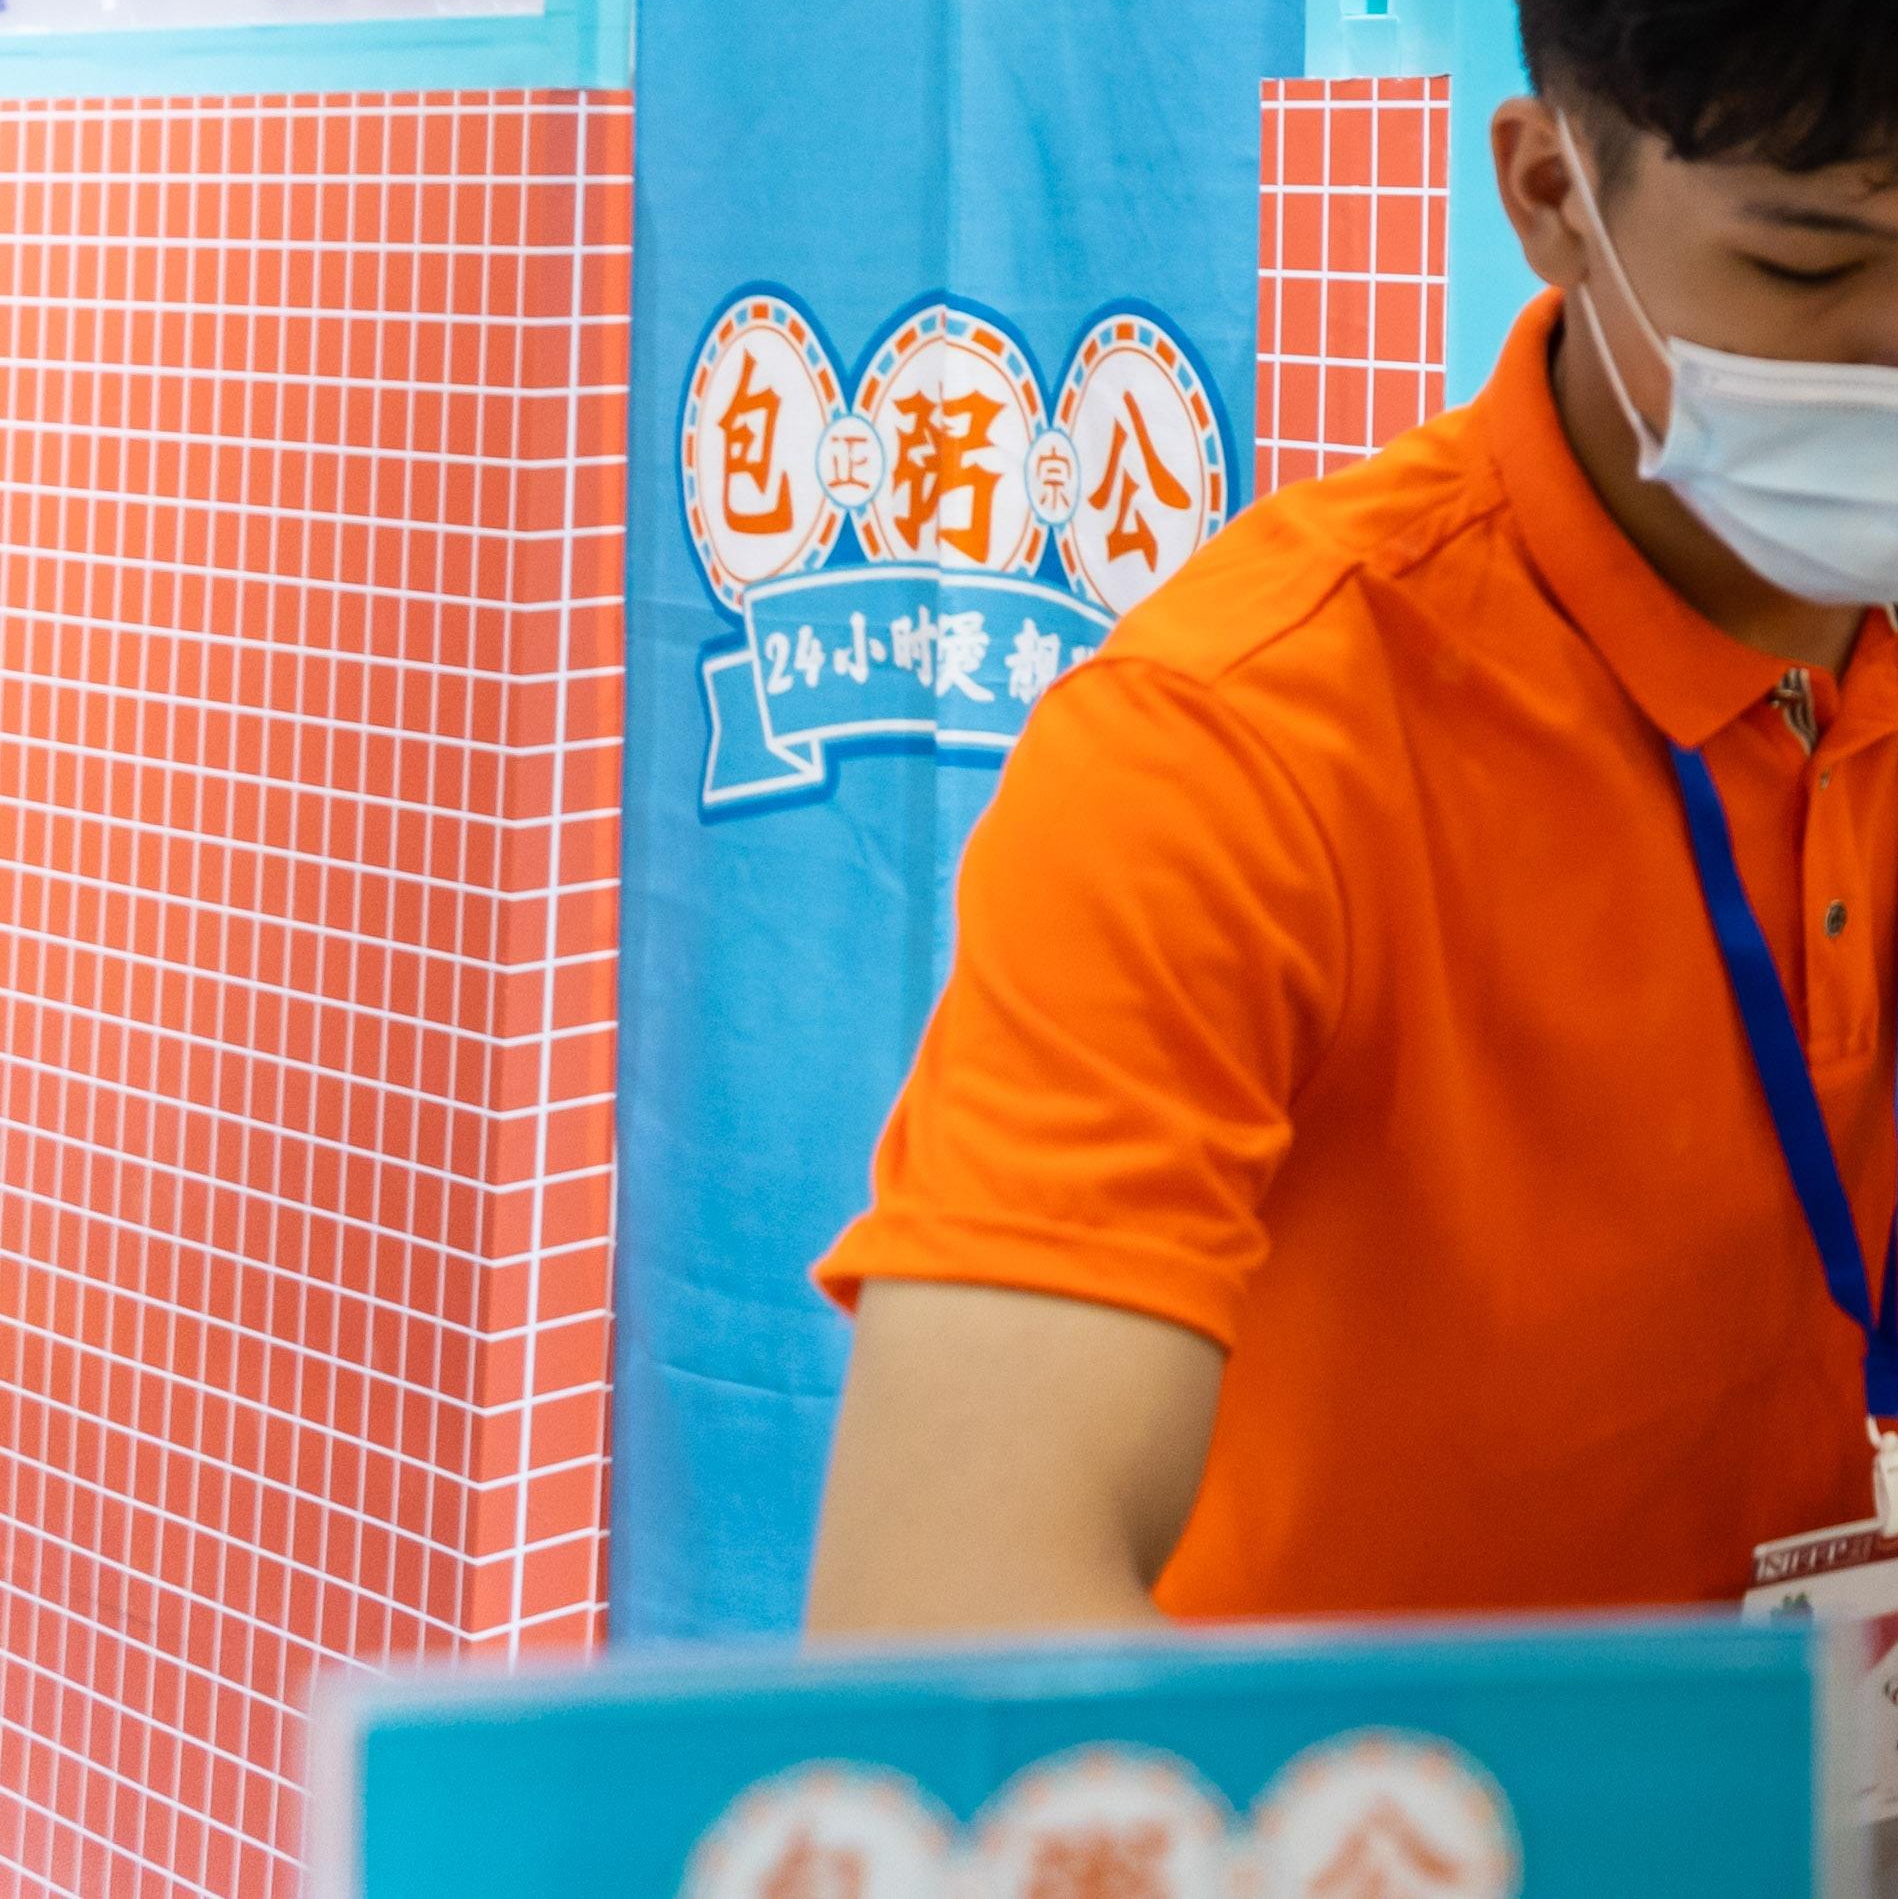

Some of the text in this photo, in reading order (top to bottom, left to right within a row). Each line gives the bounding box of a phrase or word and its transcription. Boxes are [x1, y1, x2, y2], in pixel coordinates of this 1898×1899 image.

[716, 347, 1193, 575] 包粥公
[828, 435, 1072, 509] 正 宗
[765, 605, 1100, 703] 24小时煲靓
